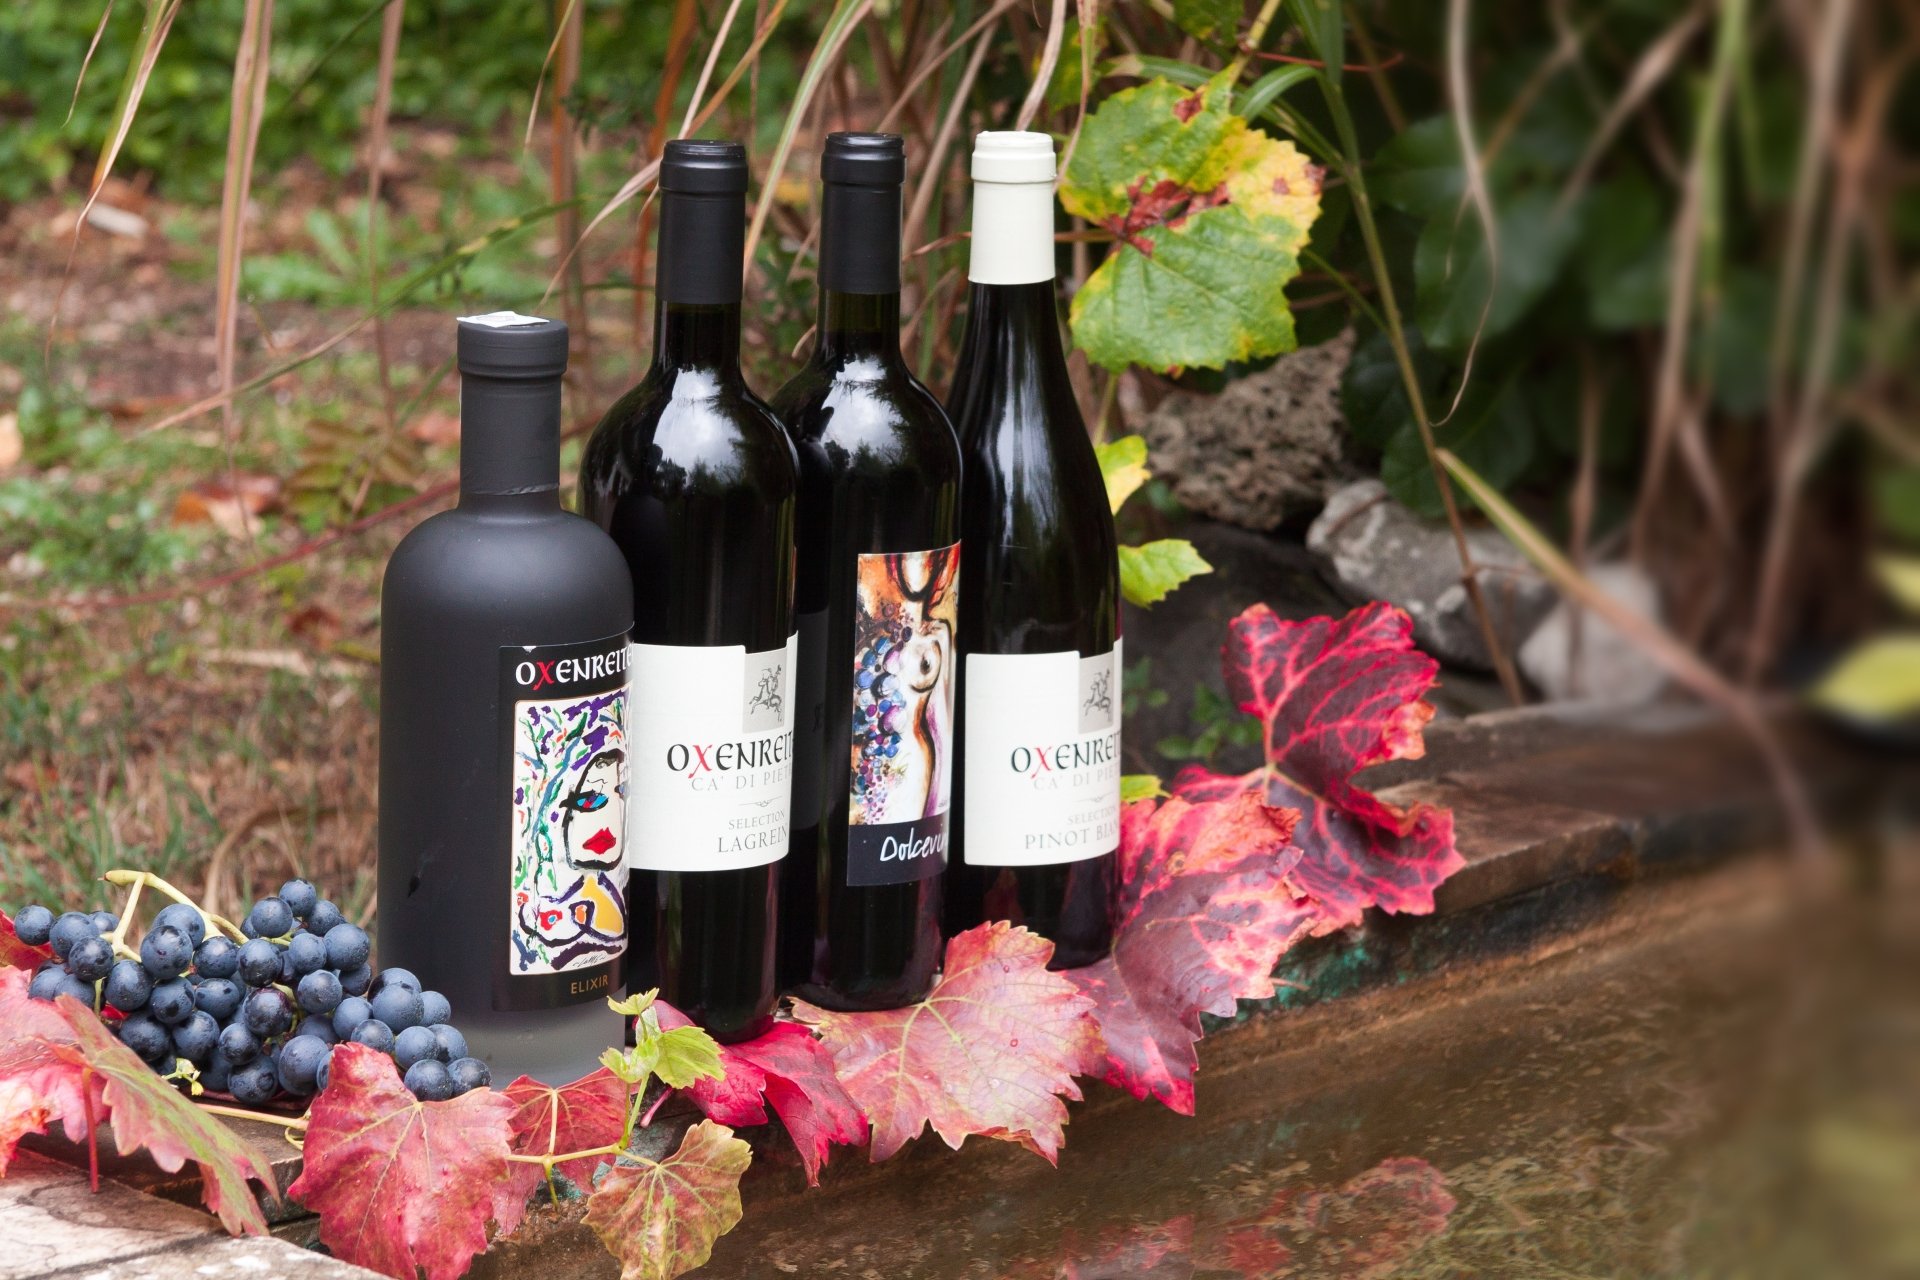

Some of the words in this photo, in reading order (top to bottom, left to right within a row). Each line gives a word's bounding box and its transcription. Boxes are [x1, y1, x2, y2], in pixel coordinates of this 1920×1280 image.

[736, 773, 755, 790] DI
[1073, 772, 1090, 787] DI
[728, 809, 786, 831] SELECTION
[1025, 828, 1090, 850] PINOT
[570, 974, 609, 994] ELIXIR
